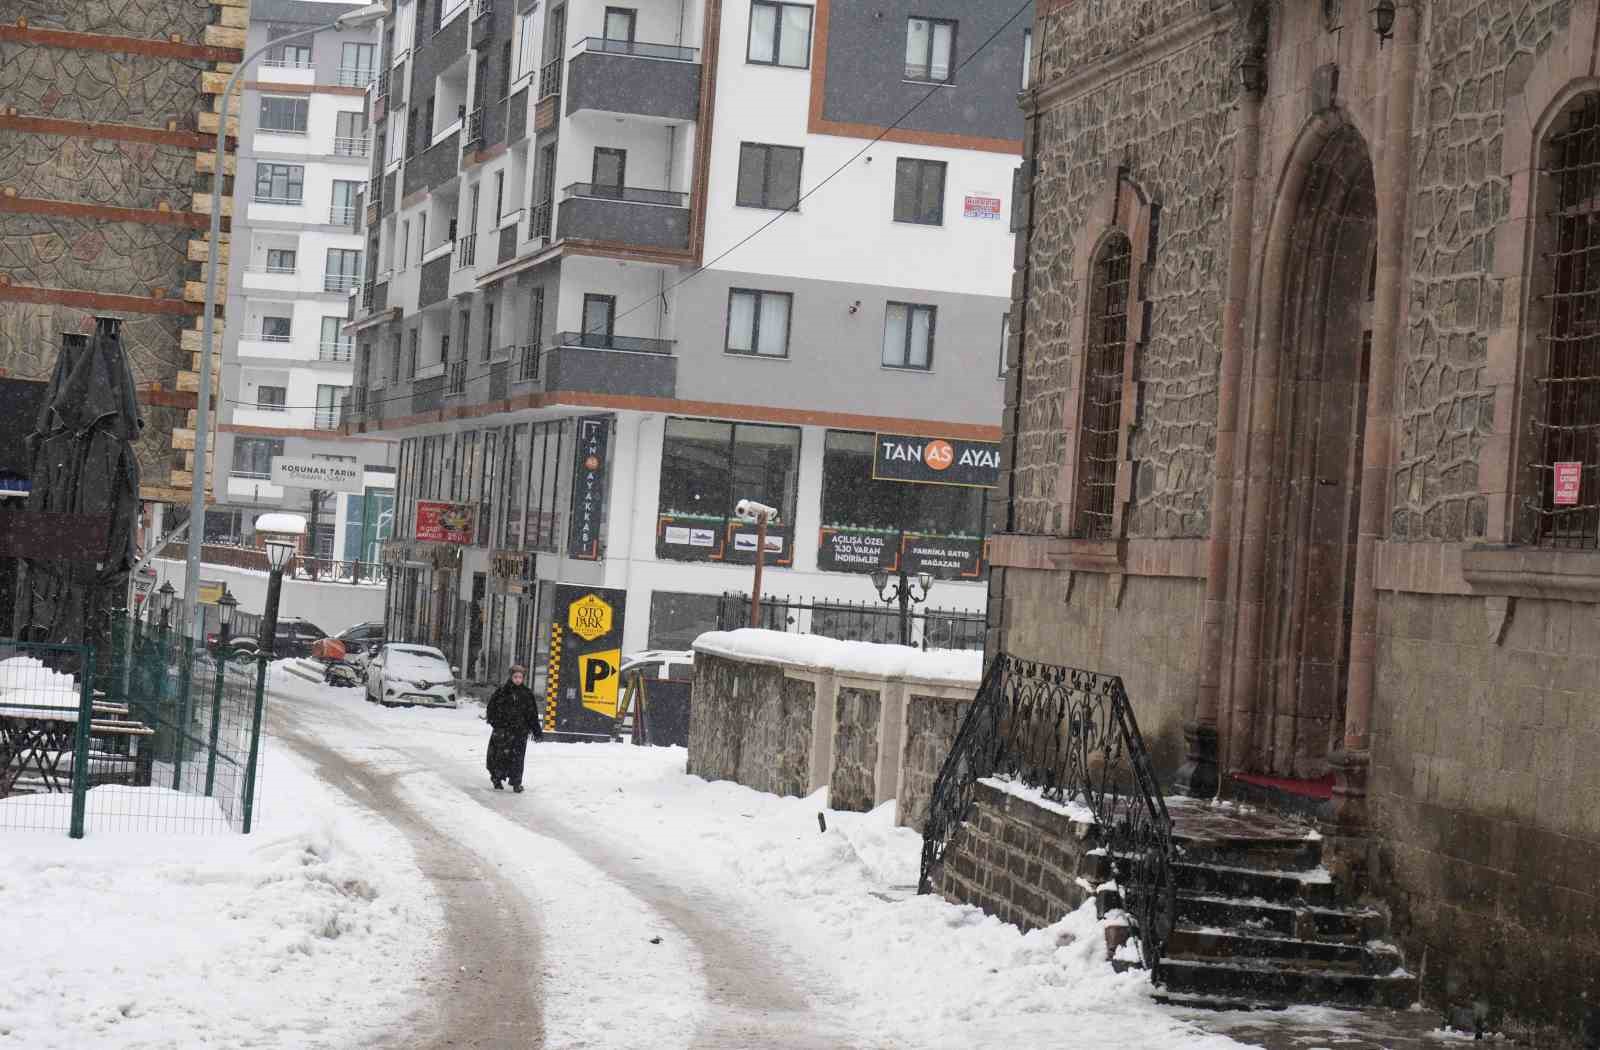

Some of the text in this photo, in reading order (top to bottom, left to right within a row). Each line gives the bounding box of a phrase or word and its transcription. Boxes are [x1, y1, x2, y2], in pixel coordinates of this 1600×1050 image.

[281, 464, 327, 475] KORUNAN
[582, 472, 594, 552] AYAKKABI
[831, 535, 885, 547] AÇILIŞA ÖZEL
[834, 552, 879, 564] İNDİRİMLER
[577, 606, 605, 618] OTO
[575, 616, 603, 629] PARK
[584, 657, 610, 693] P
